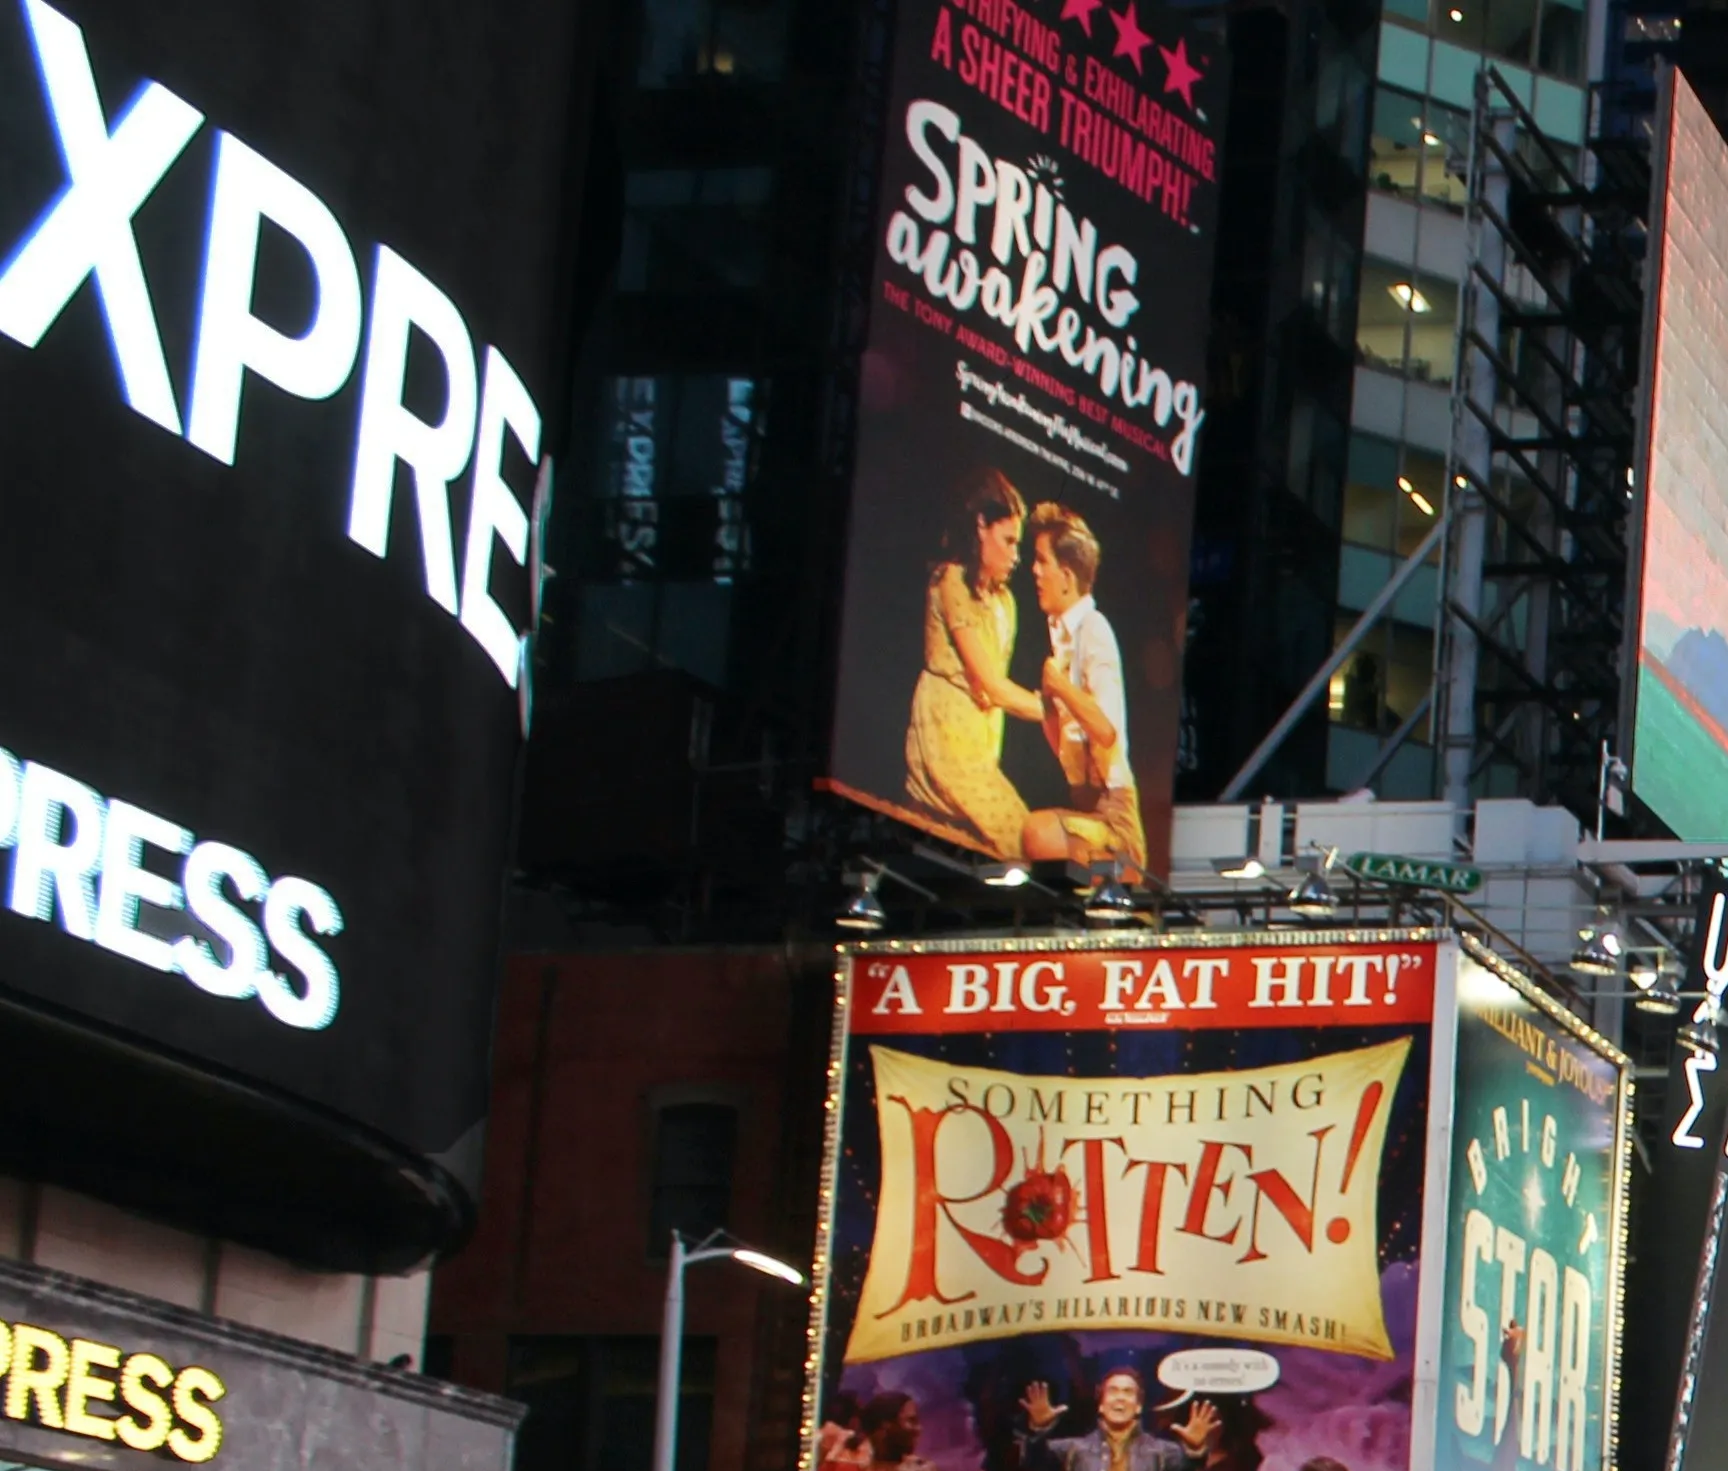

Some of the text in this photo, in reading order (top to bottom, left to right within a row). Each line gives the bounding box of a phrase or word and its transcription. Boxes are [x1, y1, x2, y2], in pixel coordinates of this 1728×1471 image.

[931, 6, 951, 70] A
[958, 23, 1050, 134] SHEER
[953, 0, 1061, 75] RIFYING
[1065, 53, 1078, 86] &
[905, 99, 1140, 328] SPRING
[0, 0, 553, 740] XPRE
[882, 280, 909, 312] THE
[914, 295, 953, 335] TONY
[1078, 395, 1108, 426] BEST
[1110, 415, 1172, 462] MUSICAL
[886, 212, 1206, 476] awakening
[0, 745, 343, 1030] RESS
[1361, 856, 1471, 888] LAMAR
[944, 962, 1078, 1016] BIG,
[1098, 958, 1230, 1012] FAT
[945, 1074, 1325, 1126] SOMETHING
[1546, 1038, 1557, 1071] &
[1199, 1300, 1247, 1325] NEW
[1259, 1308, 1345, 1342] SMASH!
[0, 1318, 226, 1463] RESS
